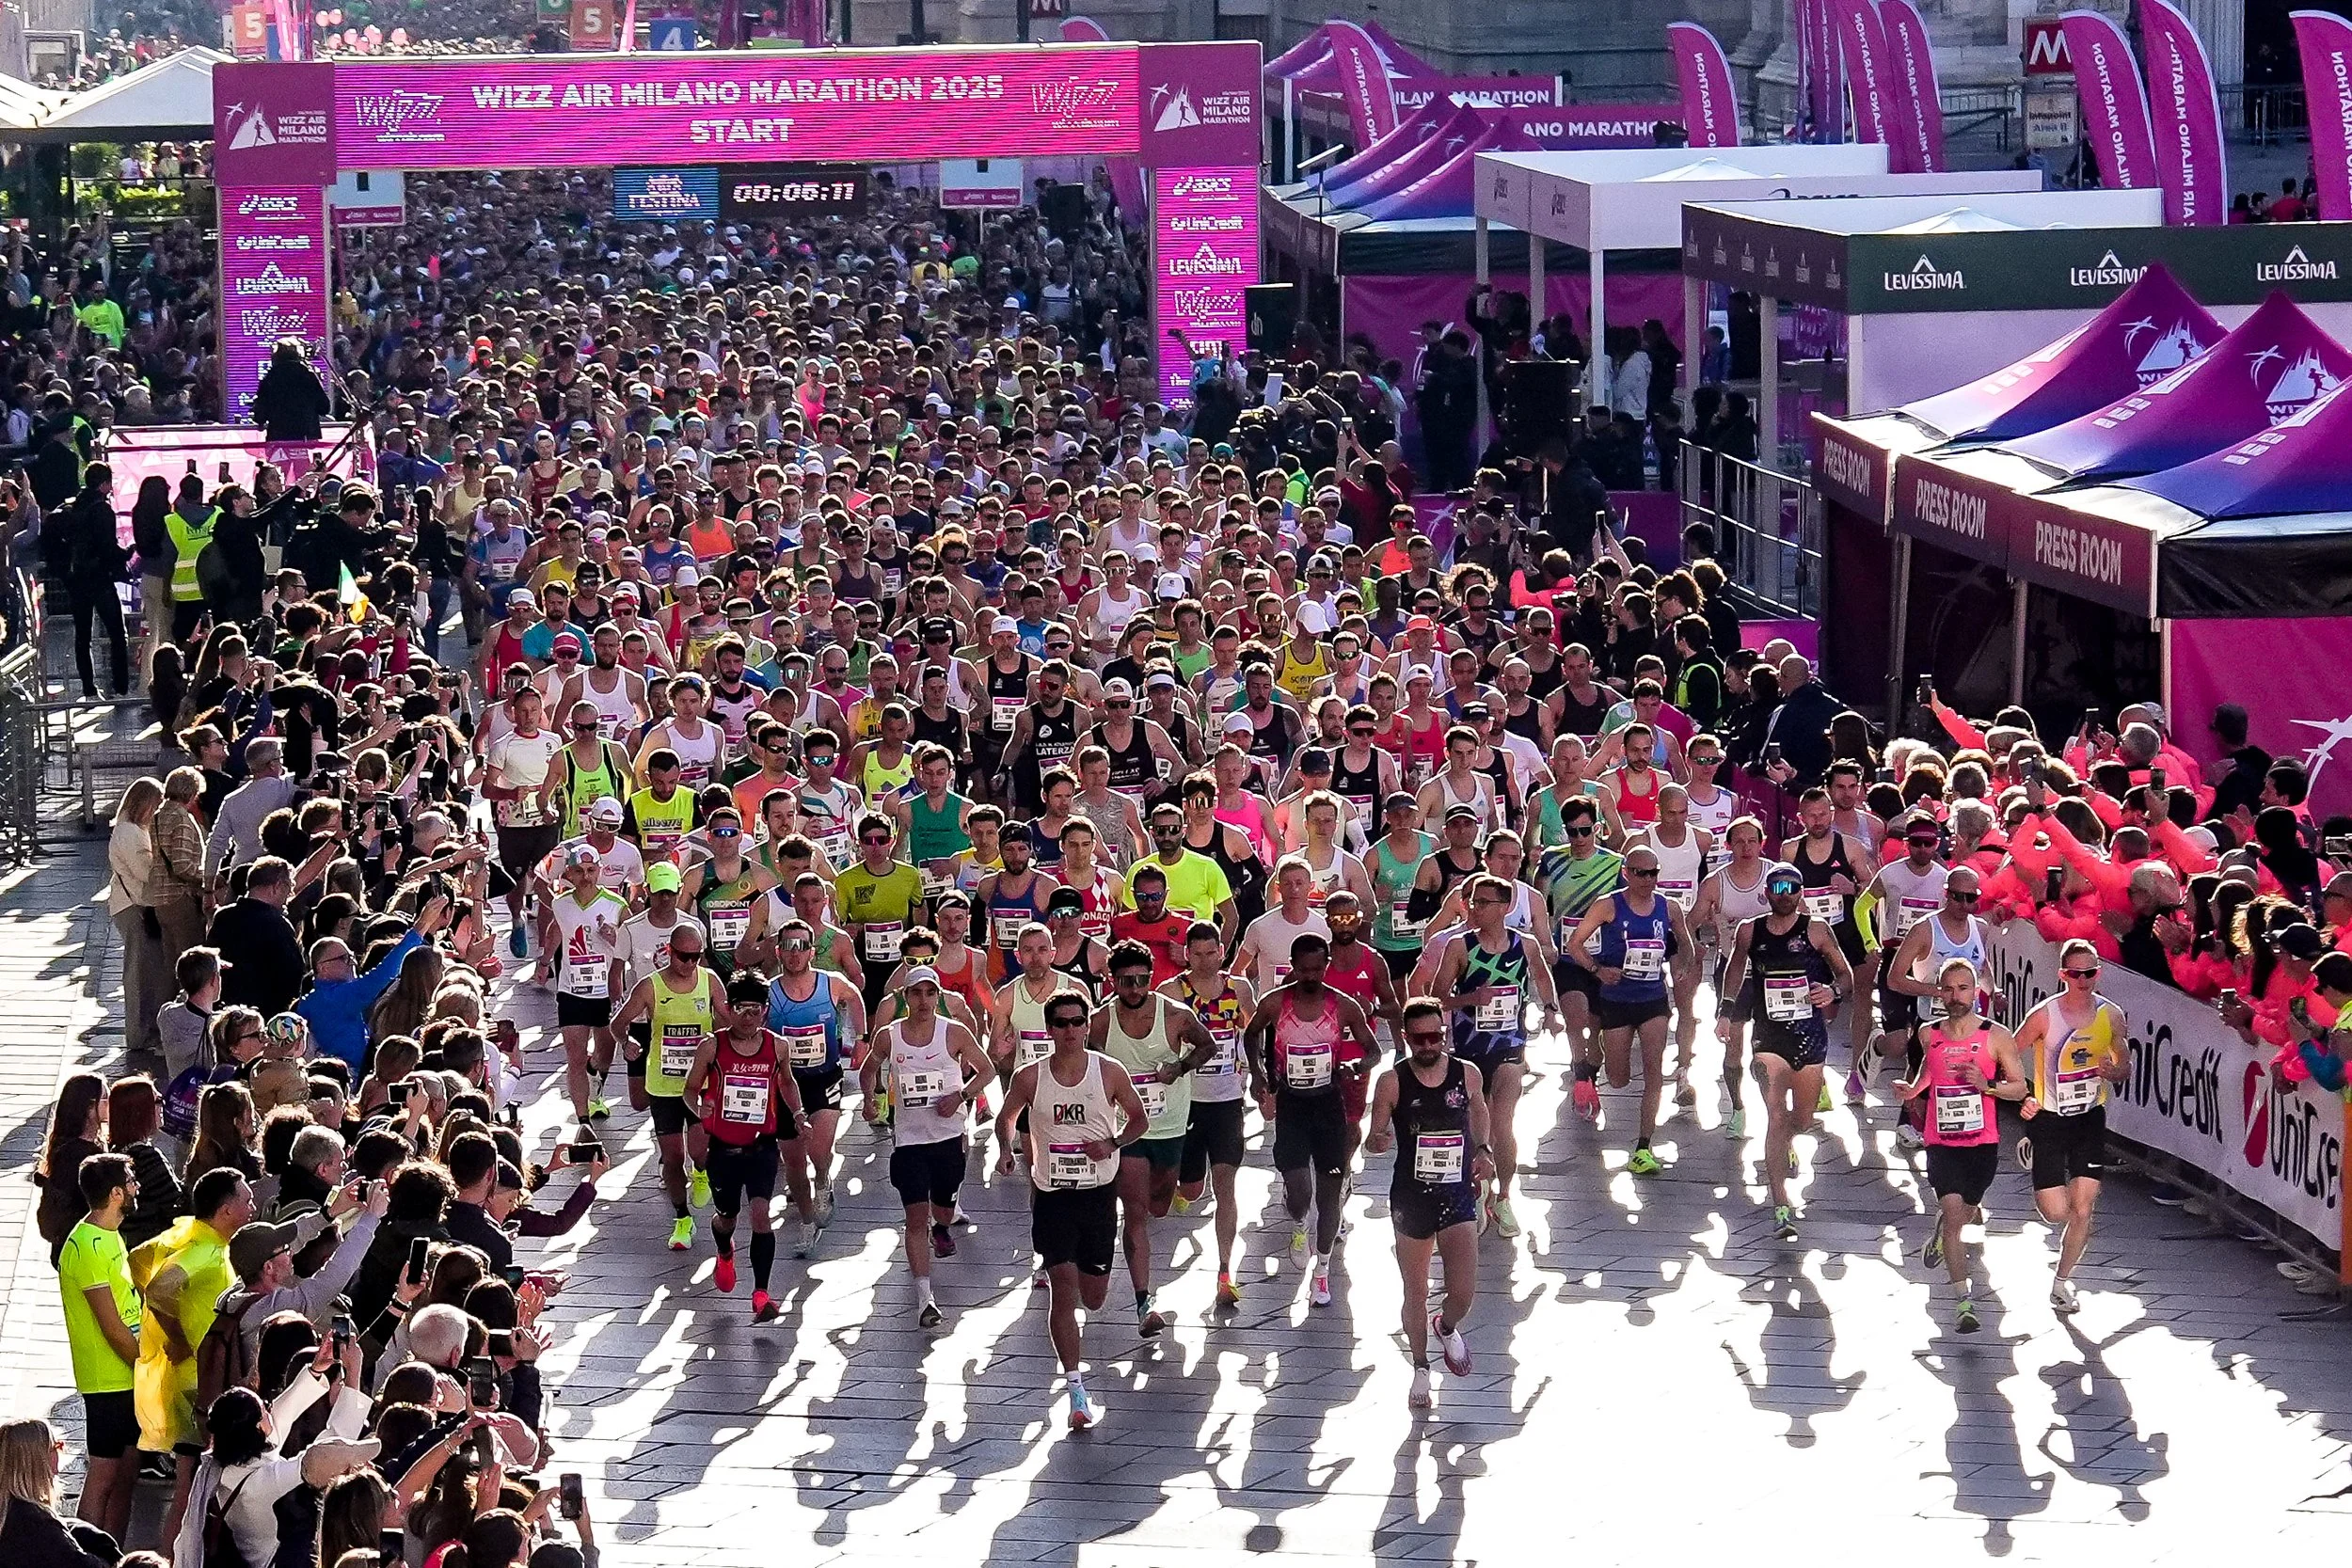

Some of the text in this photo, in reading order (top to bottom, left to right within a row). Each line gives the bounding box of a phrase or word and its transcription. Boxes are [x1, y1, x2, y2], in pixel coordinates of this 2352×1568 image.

[246, 12, 264, 38] 5
[584, 8, 602, 33] 5
[661, 27, 683, 50] 4
[2028, 30, 2072, 65] M
[471, 74, 1004, 108] WIZZ AIR MILANO MARATHON 2025
[1202, 96, 1249, 105] WIZZ AIR
[1395, 91, 1435, 105] ILAN
[278, 115, 326, 125] WIZZ AIR
[1202, 105, 1250, 116] MILANO
[1202, 116, 1250, 125] MARATHON
[278, 125, 326, 135] MILANO
[689, 118, 795, 144] START
[1884, 270, 1963, 291] LEVISSIMA
[2257, 261, 2338, 281] LEVISSIMA
[2265, 404, 2308, 415] WIZ
[1823, 437, 1871, 498] PRESS ROOM
[1915, 479, 1987, 540] PRESS ROOM
[2035, 519, 2123, 586] PRESS ROOM
[1082, 911, 1111, 923] ONACO
[667, 1026, 698, 1037] TRAFFIC
[1053, 1102, 1086, 1122] DKR
[2270, 1082, 2342, 1210] UniCre
